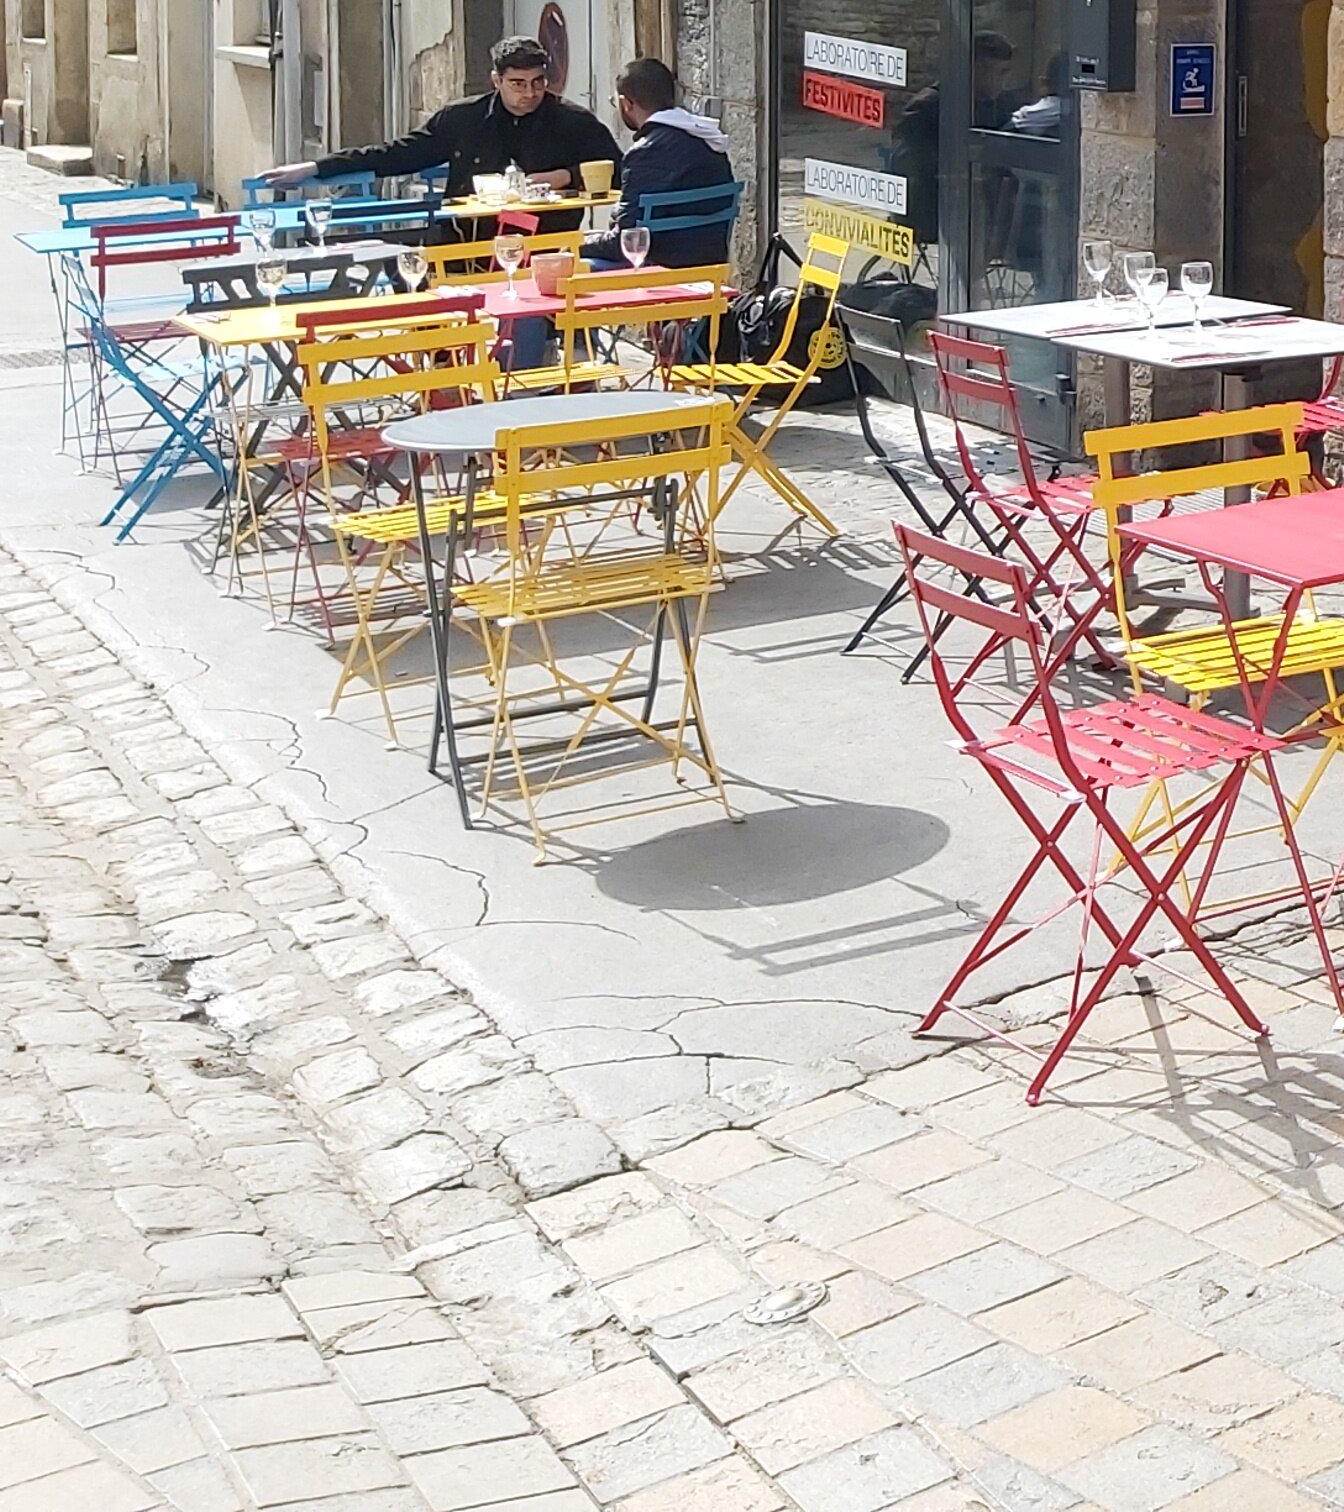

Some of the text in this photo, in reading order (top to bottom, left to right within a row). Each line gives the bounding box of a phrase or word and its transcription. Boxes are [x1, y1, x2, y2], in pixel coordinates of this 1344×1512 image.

[806, 35, 904, 81] LABORATOIRE DE
[806, 164, 904, 207] LABORATOIRE DE
